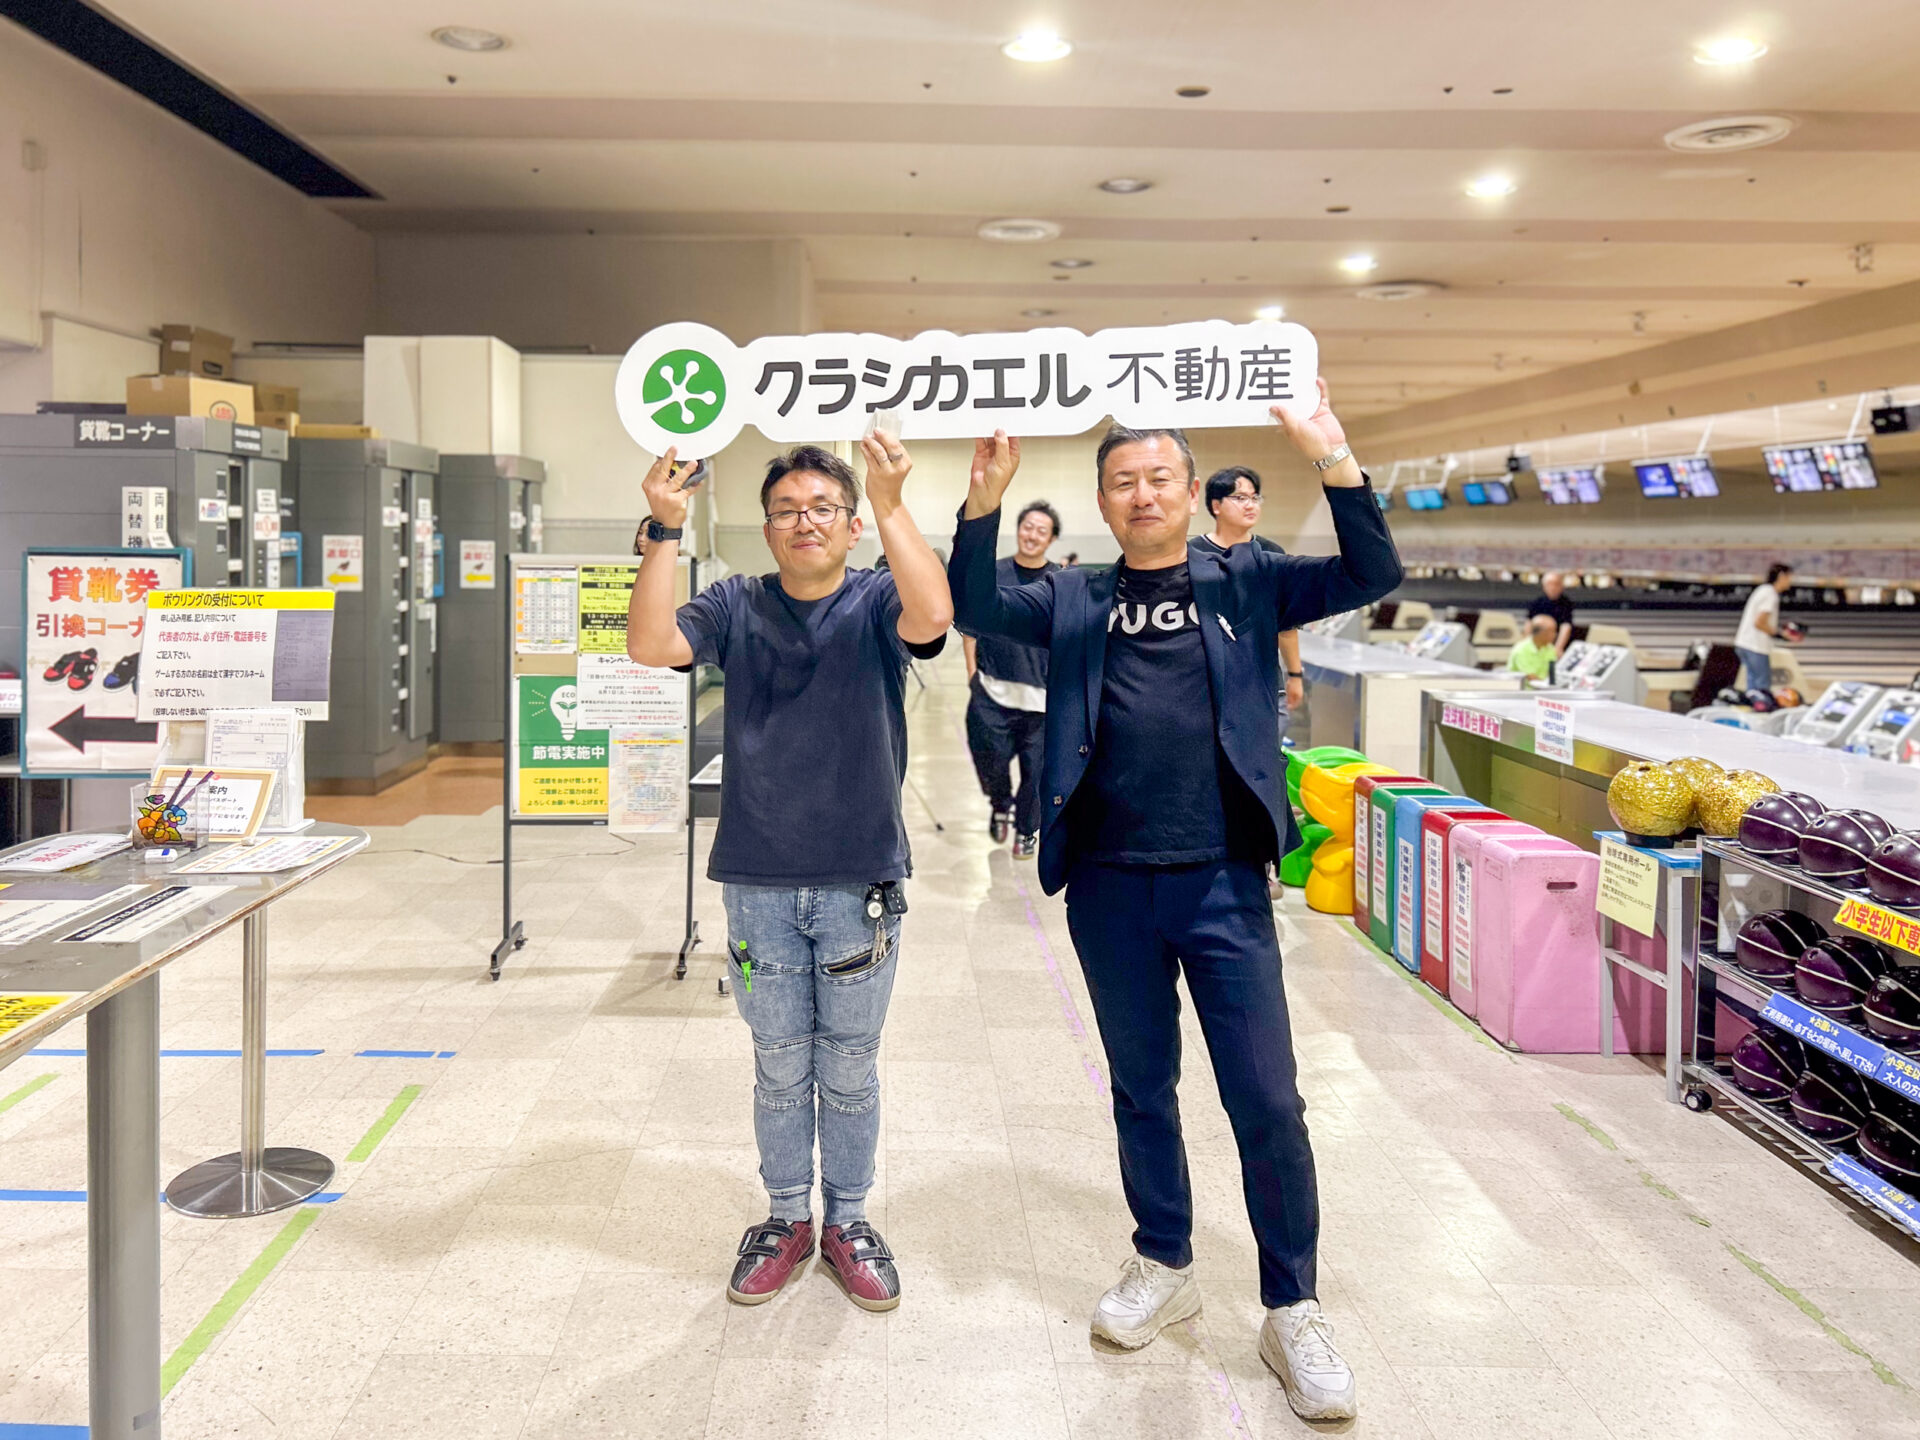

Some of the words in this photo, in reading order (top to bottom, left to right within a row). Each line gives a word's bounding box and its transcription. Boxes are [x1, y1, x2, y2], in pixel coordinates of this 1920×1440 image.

[754, 353, 1092, 418] クラシカエル
[1106, 343, 1294, 403] 不動産
[79, 420, 170, 441] 貸靴コーナー
[48, 566, 160, 604] 貸靴券
[162, 592, 265, 607] ボウリングの受付について
[36, 613, 144, 638] 引換コーナ
[532, 745, 605, 760] 節電実施中
[1883, 1071, 1920, 1100] 大人の方
